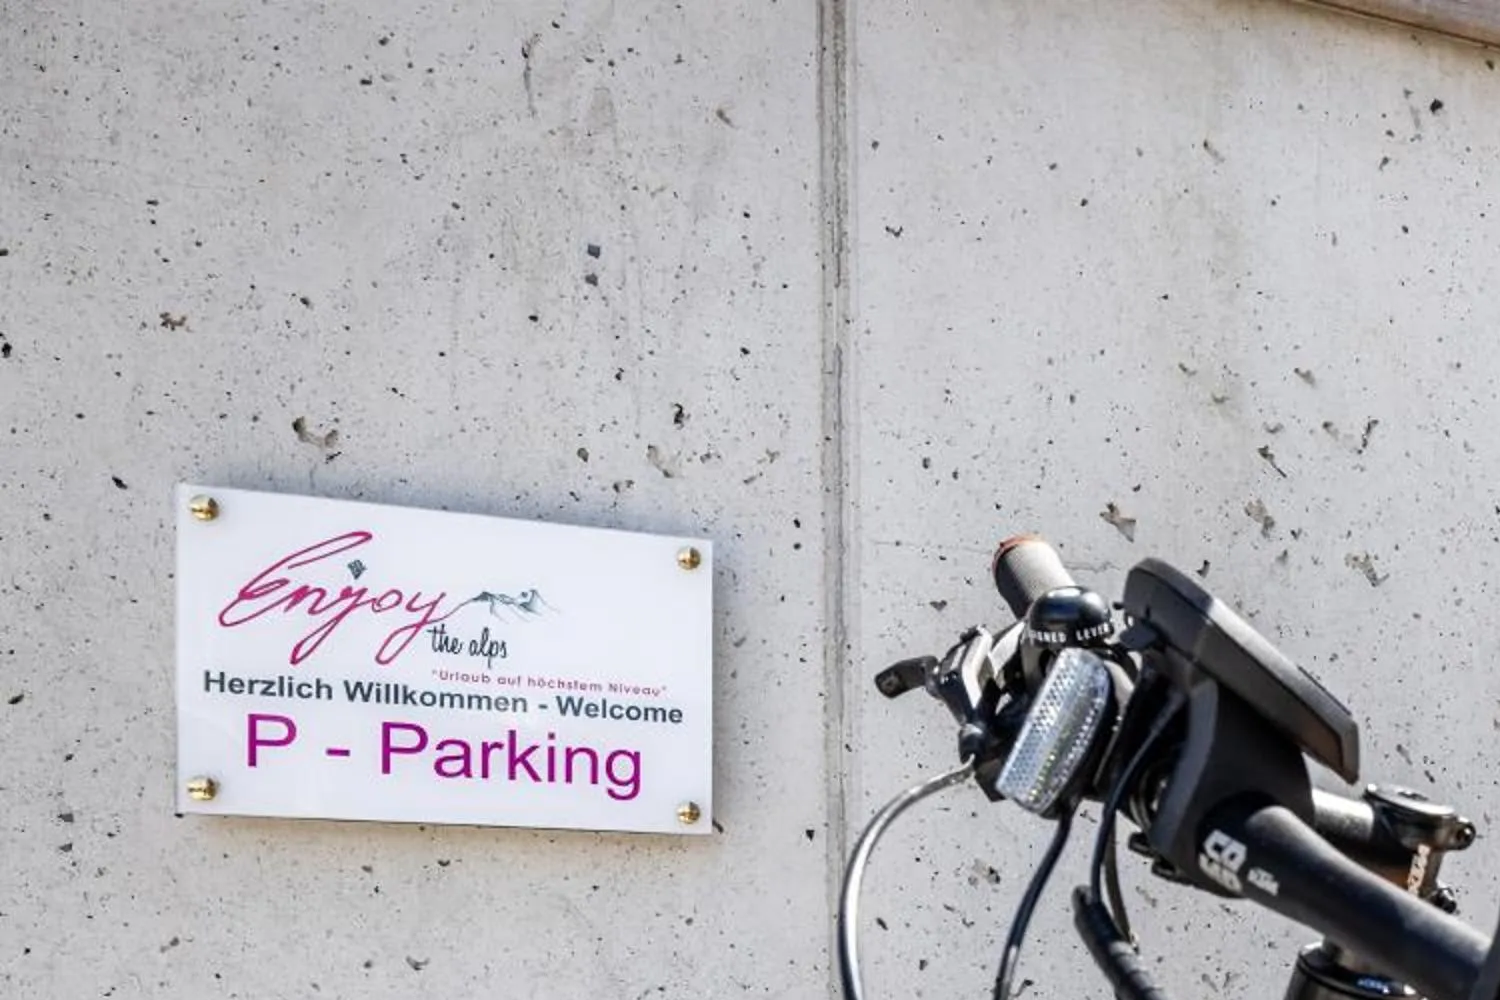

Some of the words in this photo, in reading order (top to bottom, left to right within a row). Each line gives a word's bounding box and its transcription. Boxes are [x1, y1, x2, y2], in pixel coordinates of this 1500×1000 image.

[218, 530, 447, 666] Enjoy
[427, 624, 464, 656] the
[468, 627, 508, 668] alps
[203, 671, 334, 702] Herzlich
[344, 680, 528, 714] Willkommen
[556, 695, 684, 724] Welcome
[497, 676, 522, 687] auf
[527, 676, 603, 693] höchstem
[246, 713, 297, 768] P
[381, 721, 642, 801] Parking
